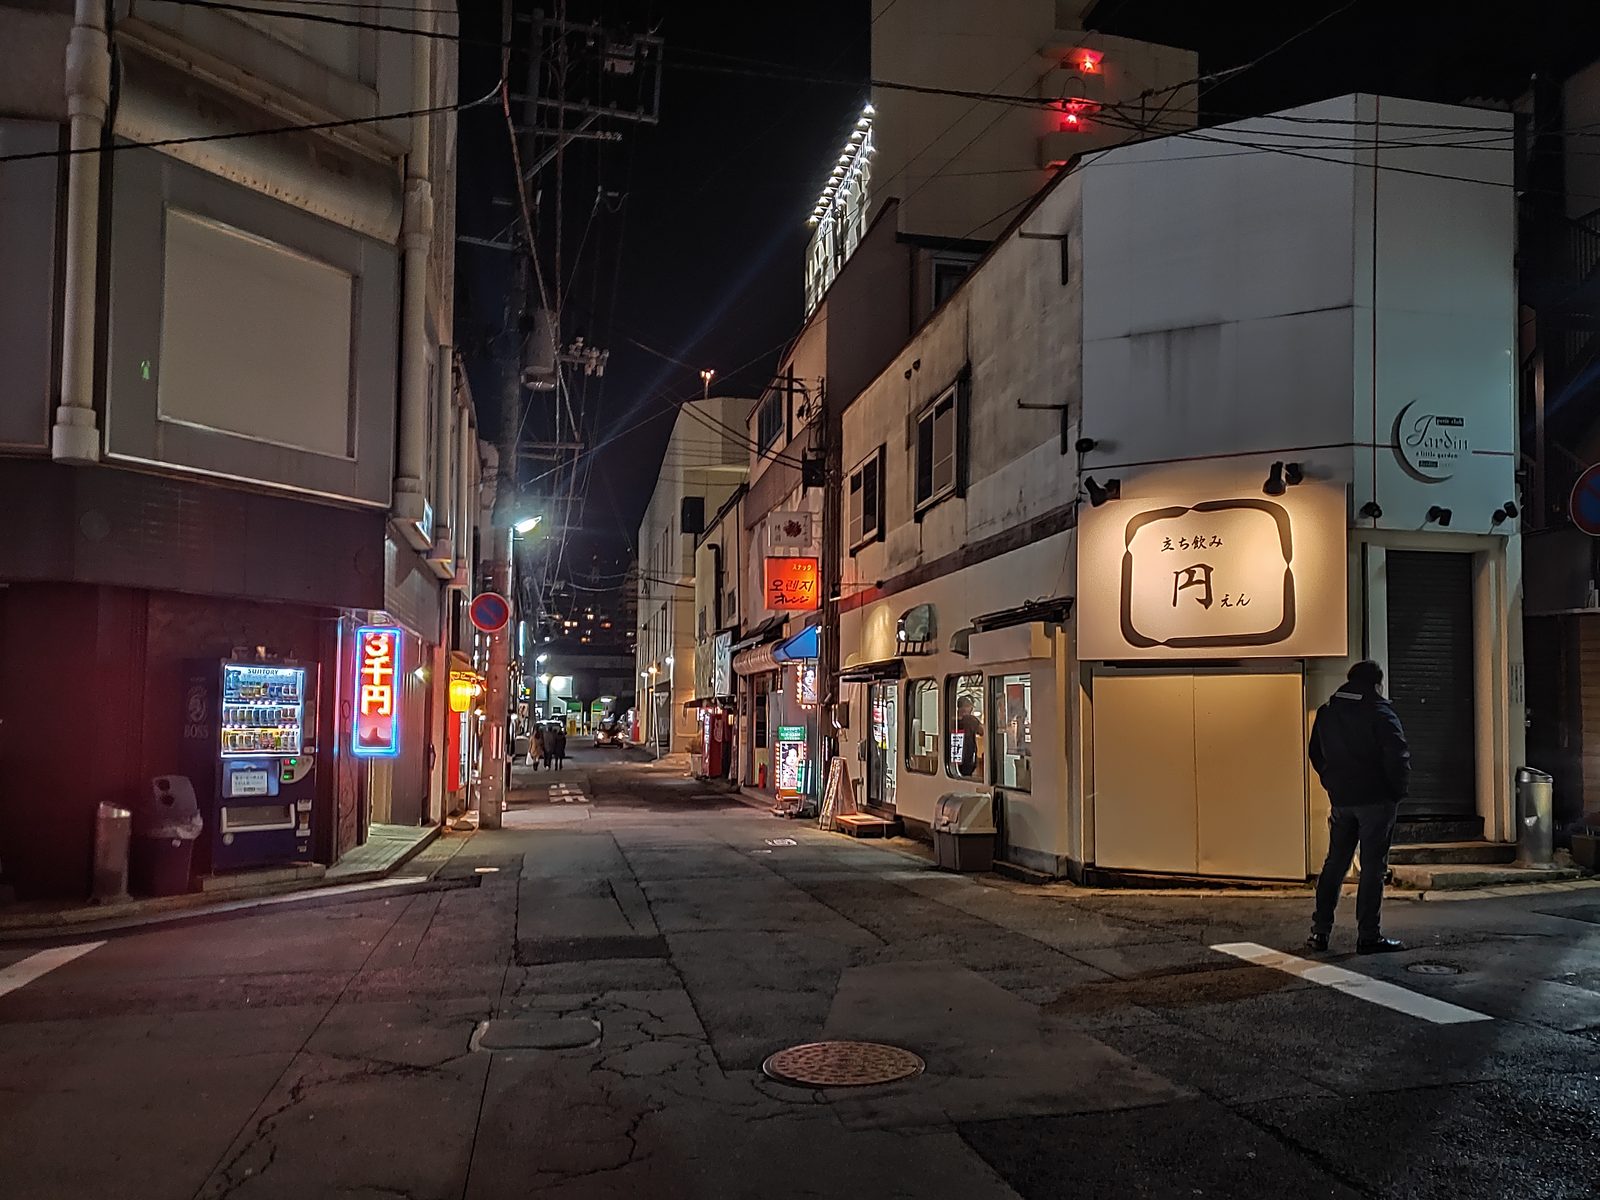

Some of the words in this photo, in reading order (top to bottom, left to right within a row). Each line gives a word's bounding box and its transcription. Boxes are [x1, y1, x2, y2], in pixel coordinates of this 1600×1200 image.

[1406, 414, 1469, 450] Jardin
[1160, 534, 1224, 553] 立ち飲み
[792, 563, 812, 571] スナック
[769, 579, 814, 593] 오렌지
[1172, 563, 1214, 610] 円
[774, 592, 810, 605] オレンジ
[1220, 593, 1252, 608] えん
[247, 667, 279, 675] SUNTORY
[361, 632, 393, 716] 3千円
[184, 724, 209, 739] BOSS
